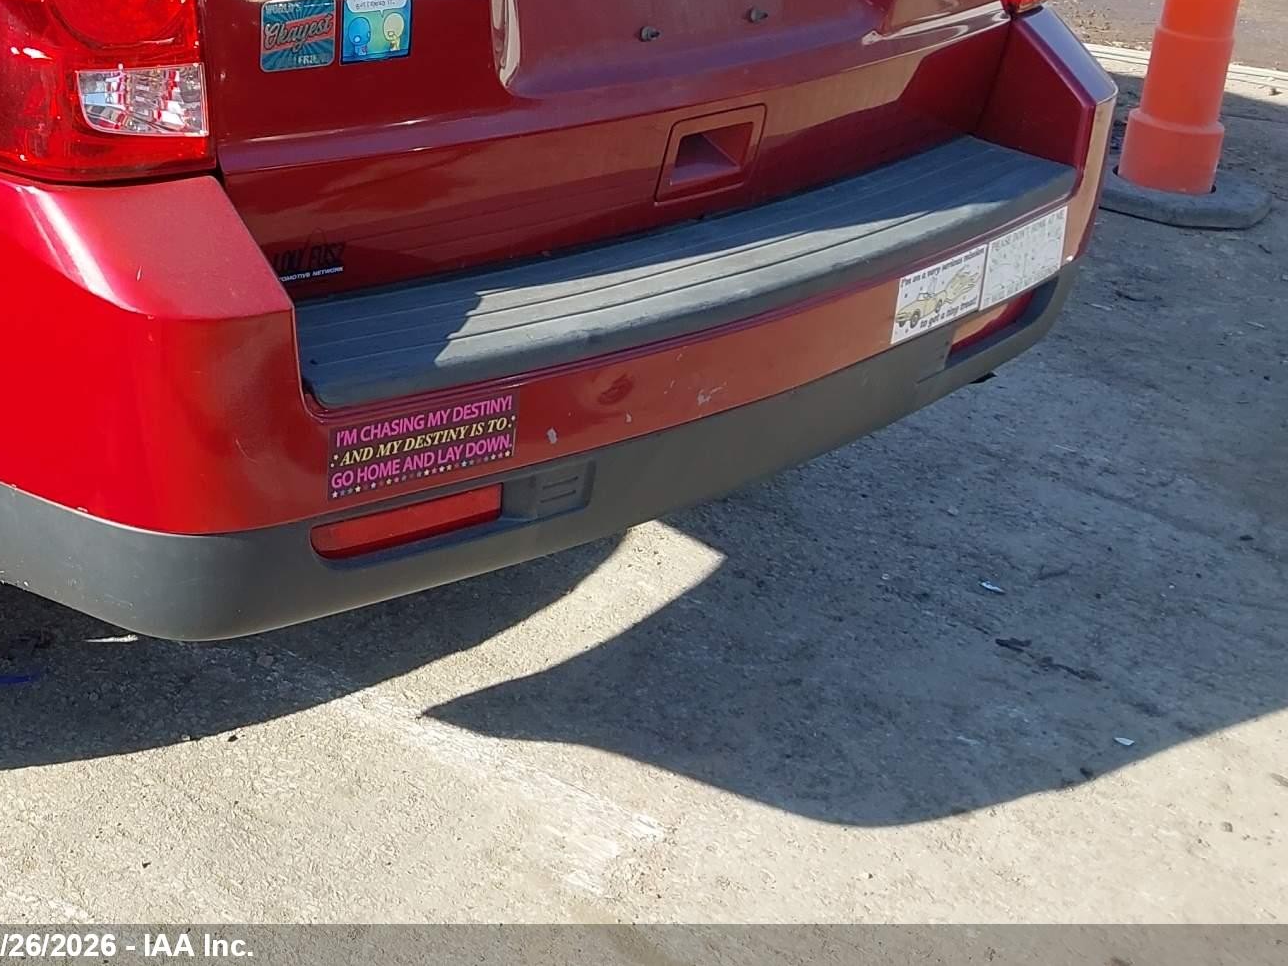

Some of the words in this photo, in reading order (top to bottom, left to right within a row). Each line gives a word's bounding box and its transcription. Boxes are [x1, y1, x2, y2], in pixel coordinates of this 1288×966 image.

[264, 14, 332, 52] Okayest
[279, 272, 311, 282] OMOTIVE
[336, 429, 358, 448] I'M
[360, 414, 425, 443] CHASING
[427, 409, 451, 427] MY
[452, 396, 513, 422] DESTINY!
[331, 470, 354, 489] GO
[357, 459, 400, 484] HOME
[402, 452, 435, 472] AND
[437, 446, 464, 464] LAY
[465, 434, 513, 457] DOWN.
[340, 447, 374, 467] AND
[376, 441, 402, 459] MY
[404, 426, 470, 453] DESTINY
[470, 423, 485, 437] IS
